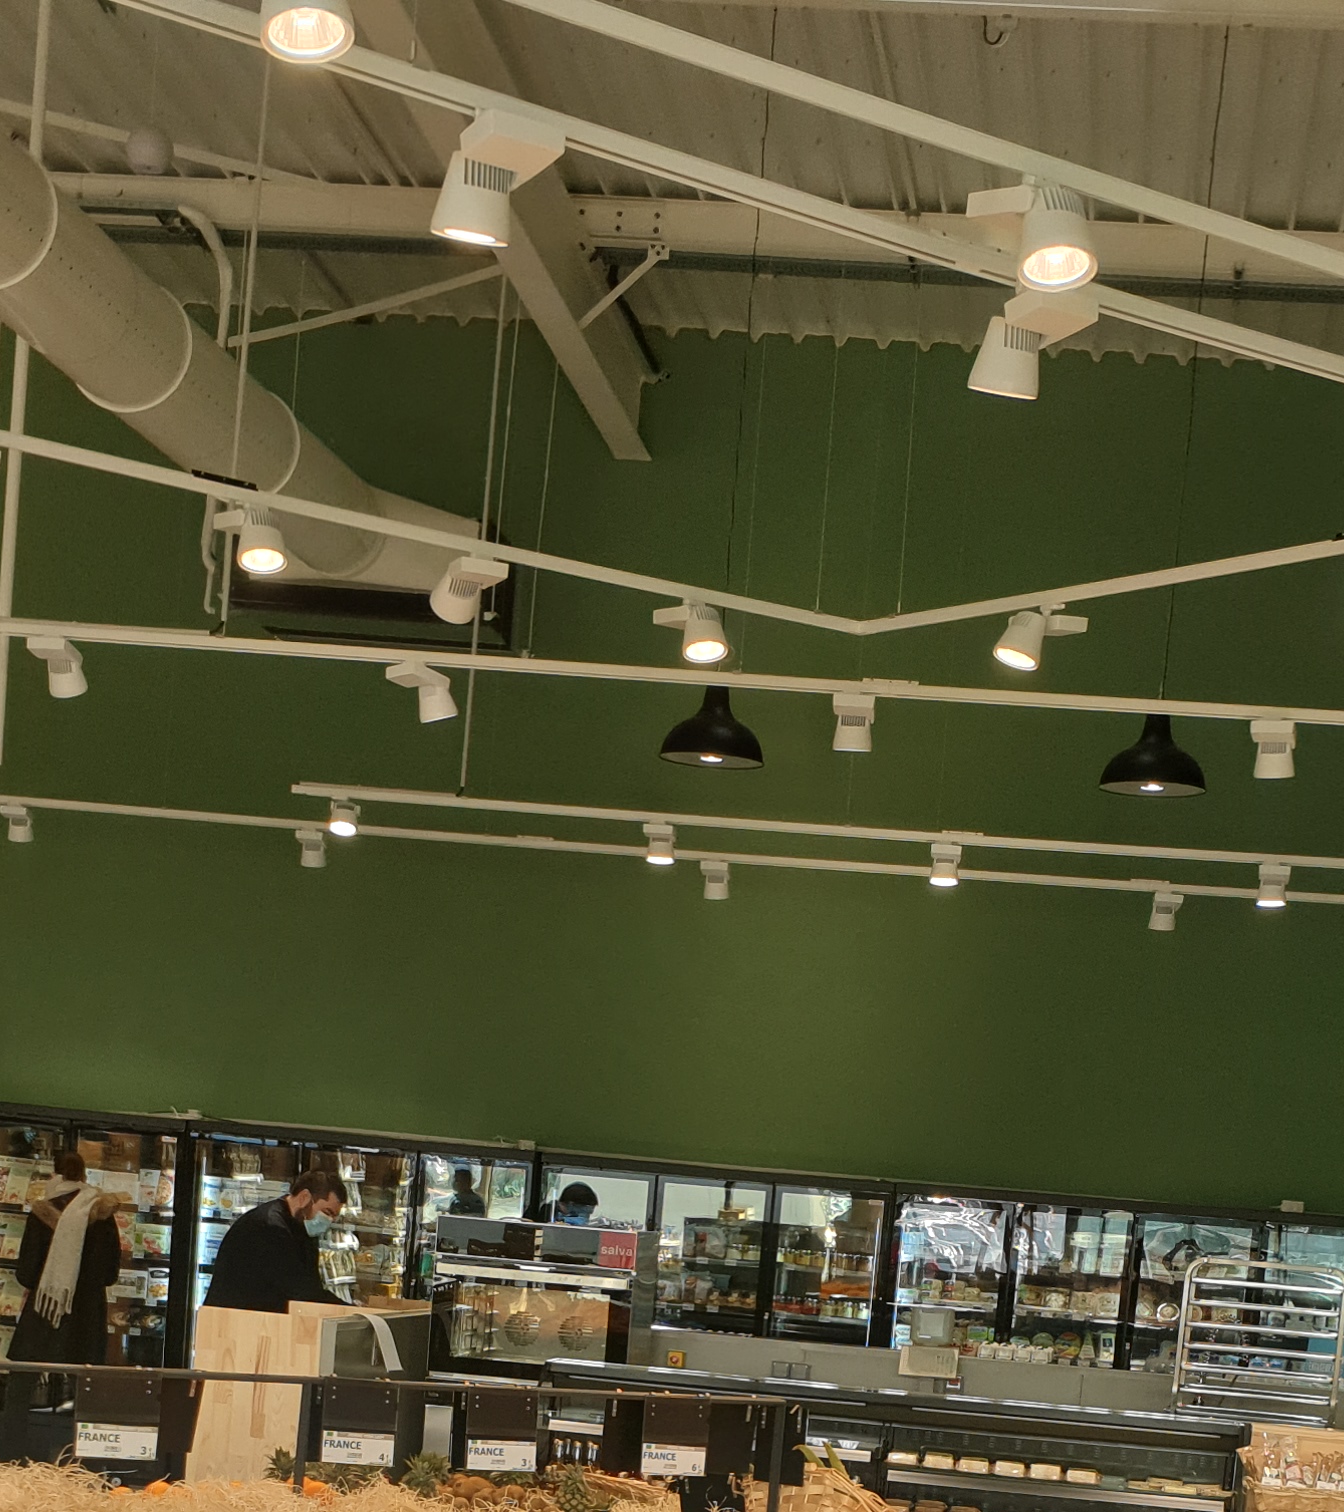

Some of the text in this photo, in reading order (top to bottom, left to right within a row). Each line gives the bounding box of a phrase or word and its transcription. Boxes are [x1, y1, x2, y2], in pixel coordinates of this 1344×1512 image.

[600, 1245, 633, 1257] salva
[78, 1432, 121, 1443] FRANCE
[324, 1440, 362, 1450] FRANCE
[468, 1447, 505, 1457] FRANCE
[643, 1451, 677, 1461] FRANCE
